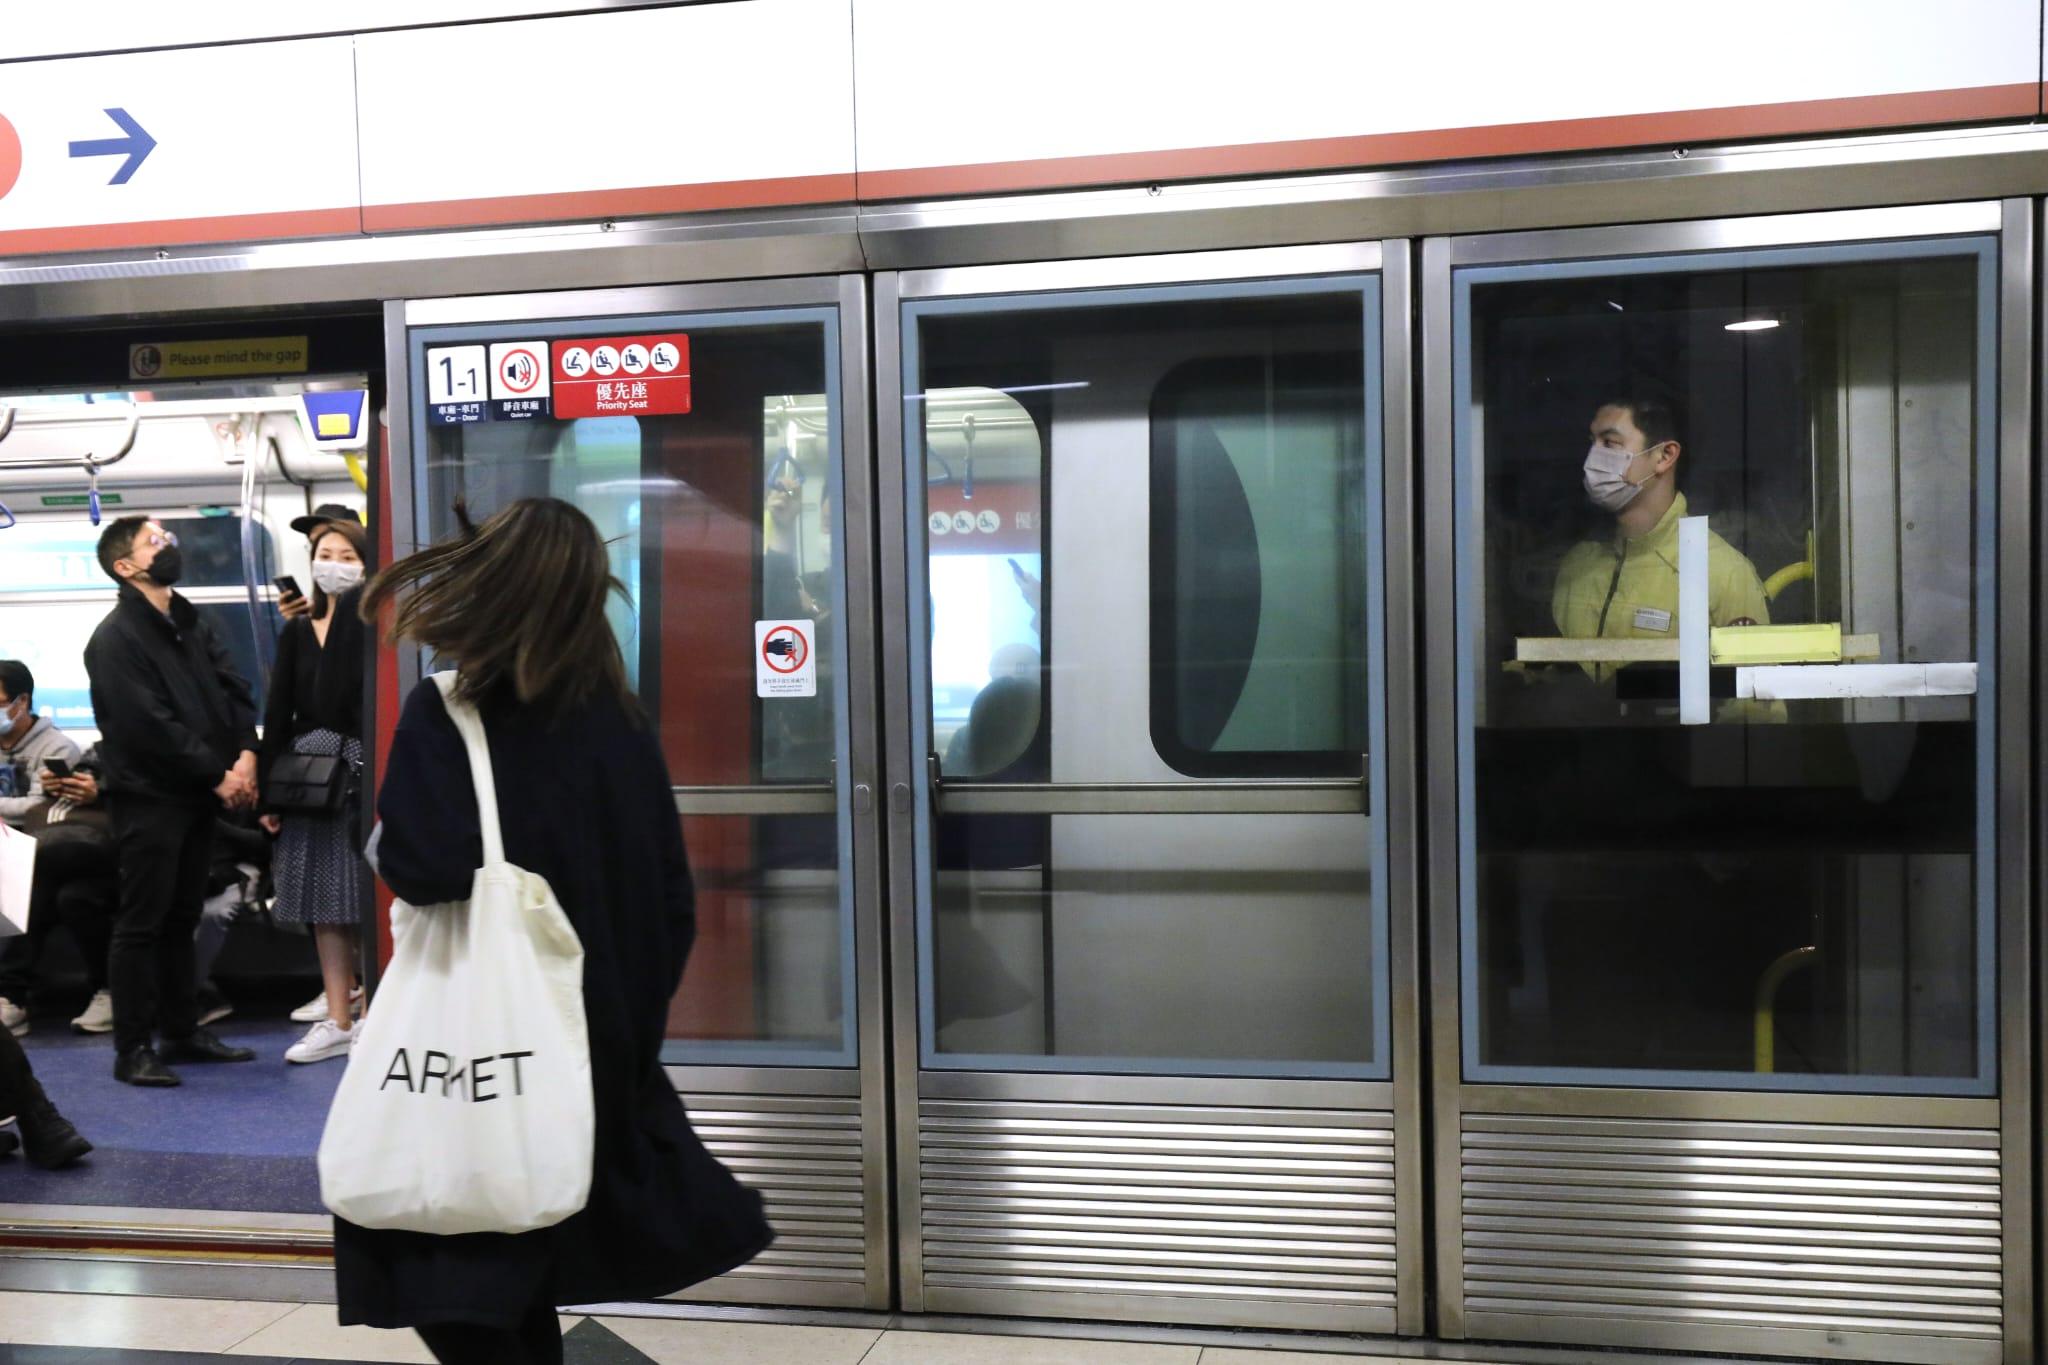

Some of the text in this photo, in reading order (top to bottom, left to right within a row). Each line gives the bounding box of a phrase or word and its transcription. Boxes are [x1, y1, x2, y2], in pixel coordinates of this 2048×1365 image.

[169, 349, 301, 366] Please mind the gap
[439, 356, 477, 396] 1-1
[596, 381, 648, 400] 優先座
[596, 400, 648, 411] Priority Seat
